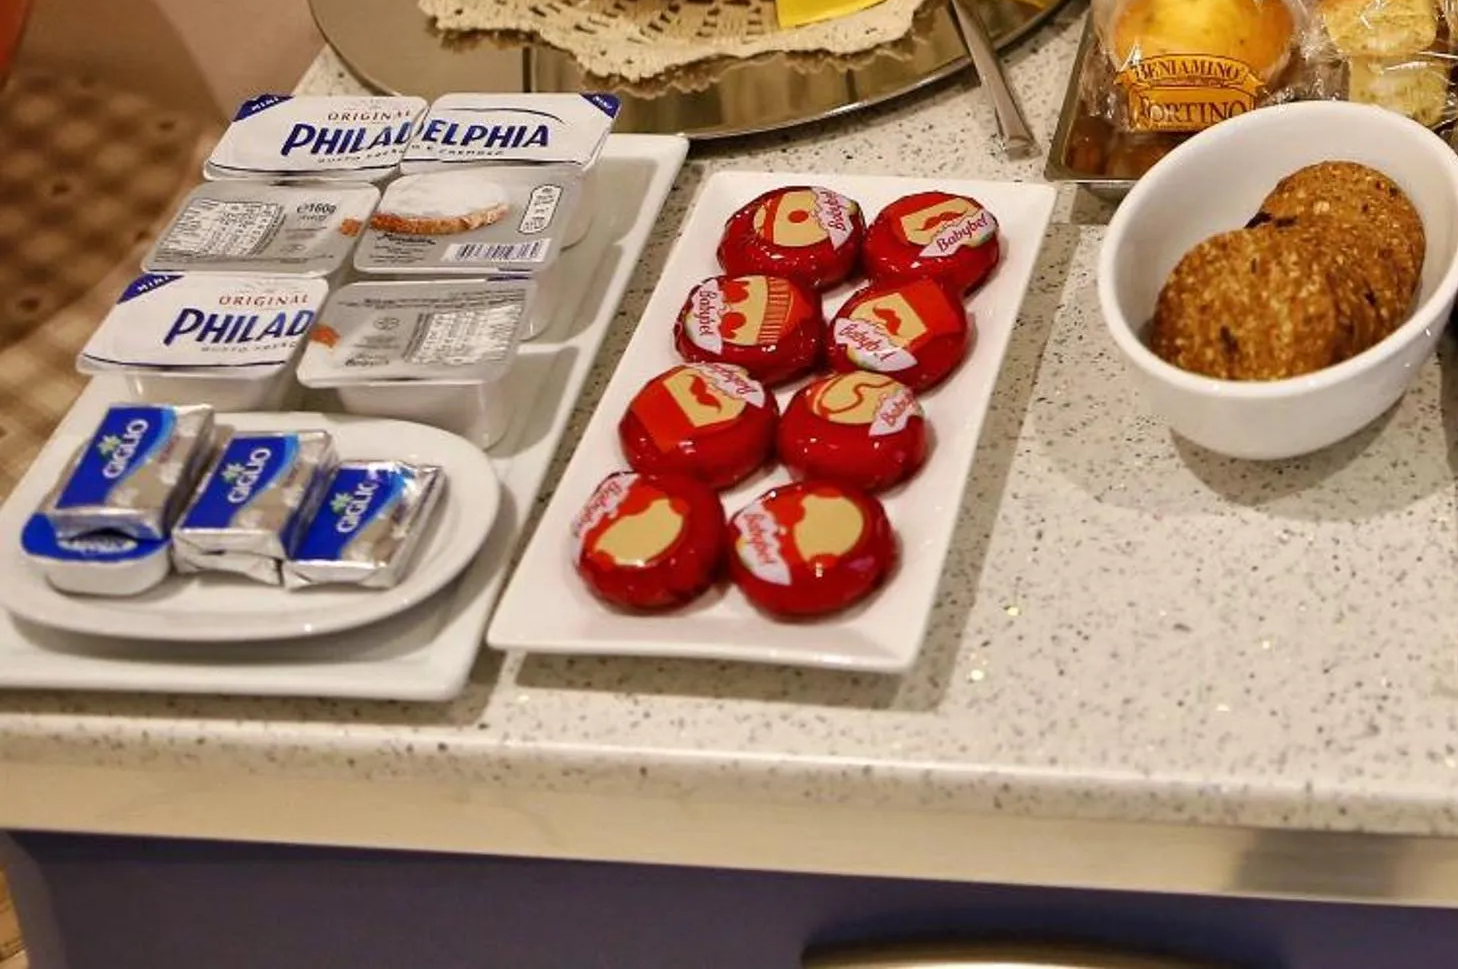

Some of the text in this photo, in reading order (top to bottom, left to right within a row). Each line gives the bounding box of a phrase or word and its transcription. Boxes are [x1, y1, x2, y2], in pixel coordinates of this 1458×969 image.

[1134, 57, 1242, 80] BENIAMINO
[936, 212, 990, 252] Babybel
[218, 293, 309, 307] ORIGINAL
[693, 289, 719, 336] Babybel
[102, 418, 149, 479] GIGLIO
[227, 446, 272, 504] GIGLIO
